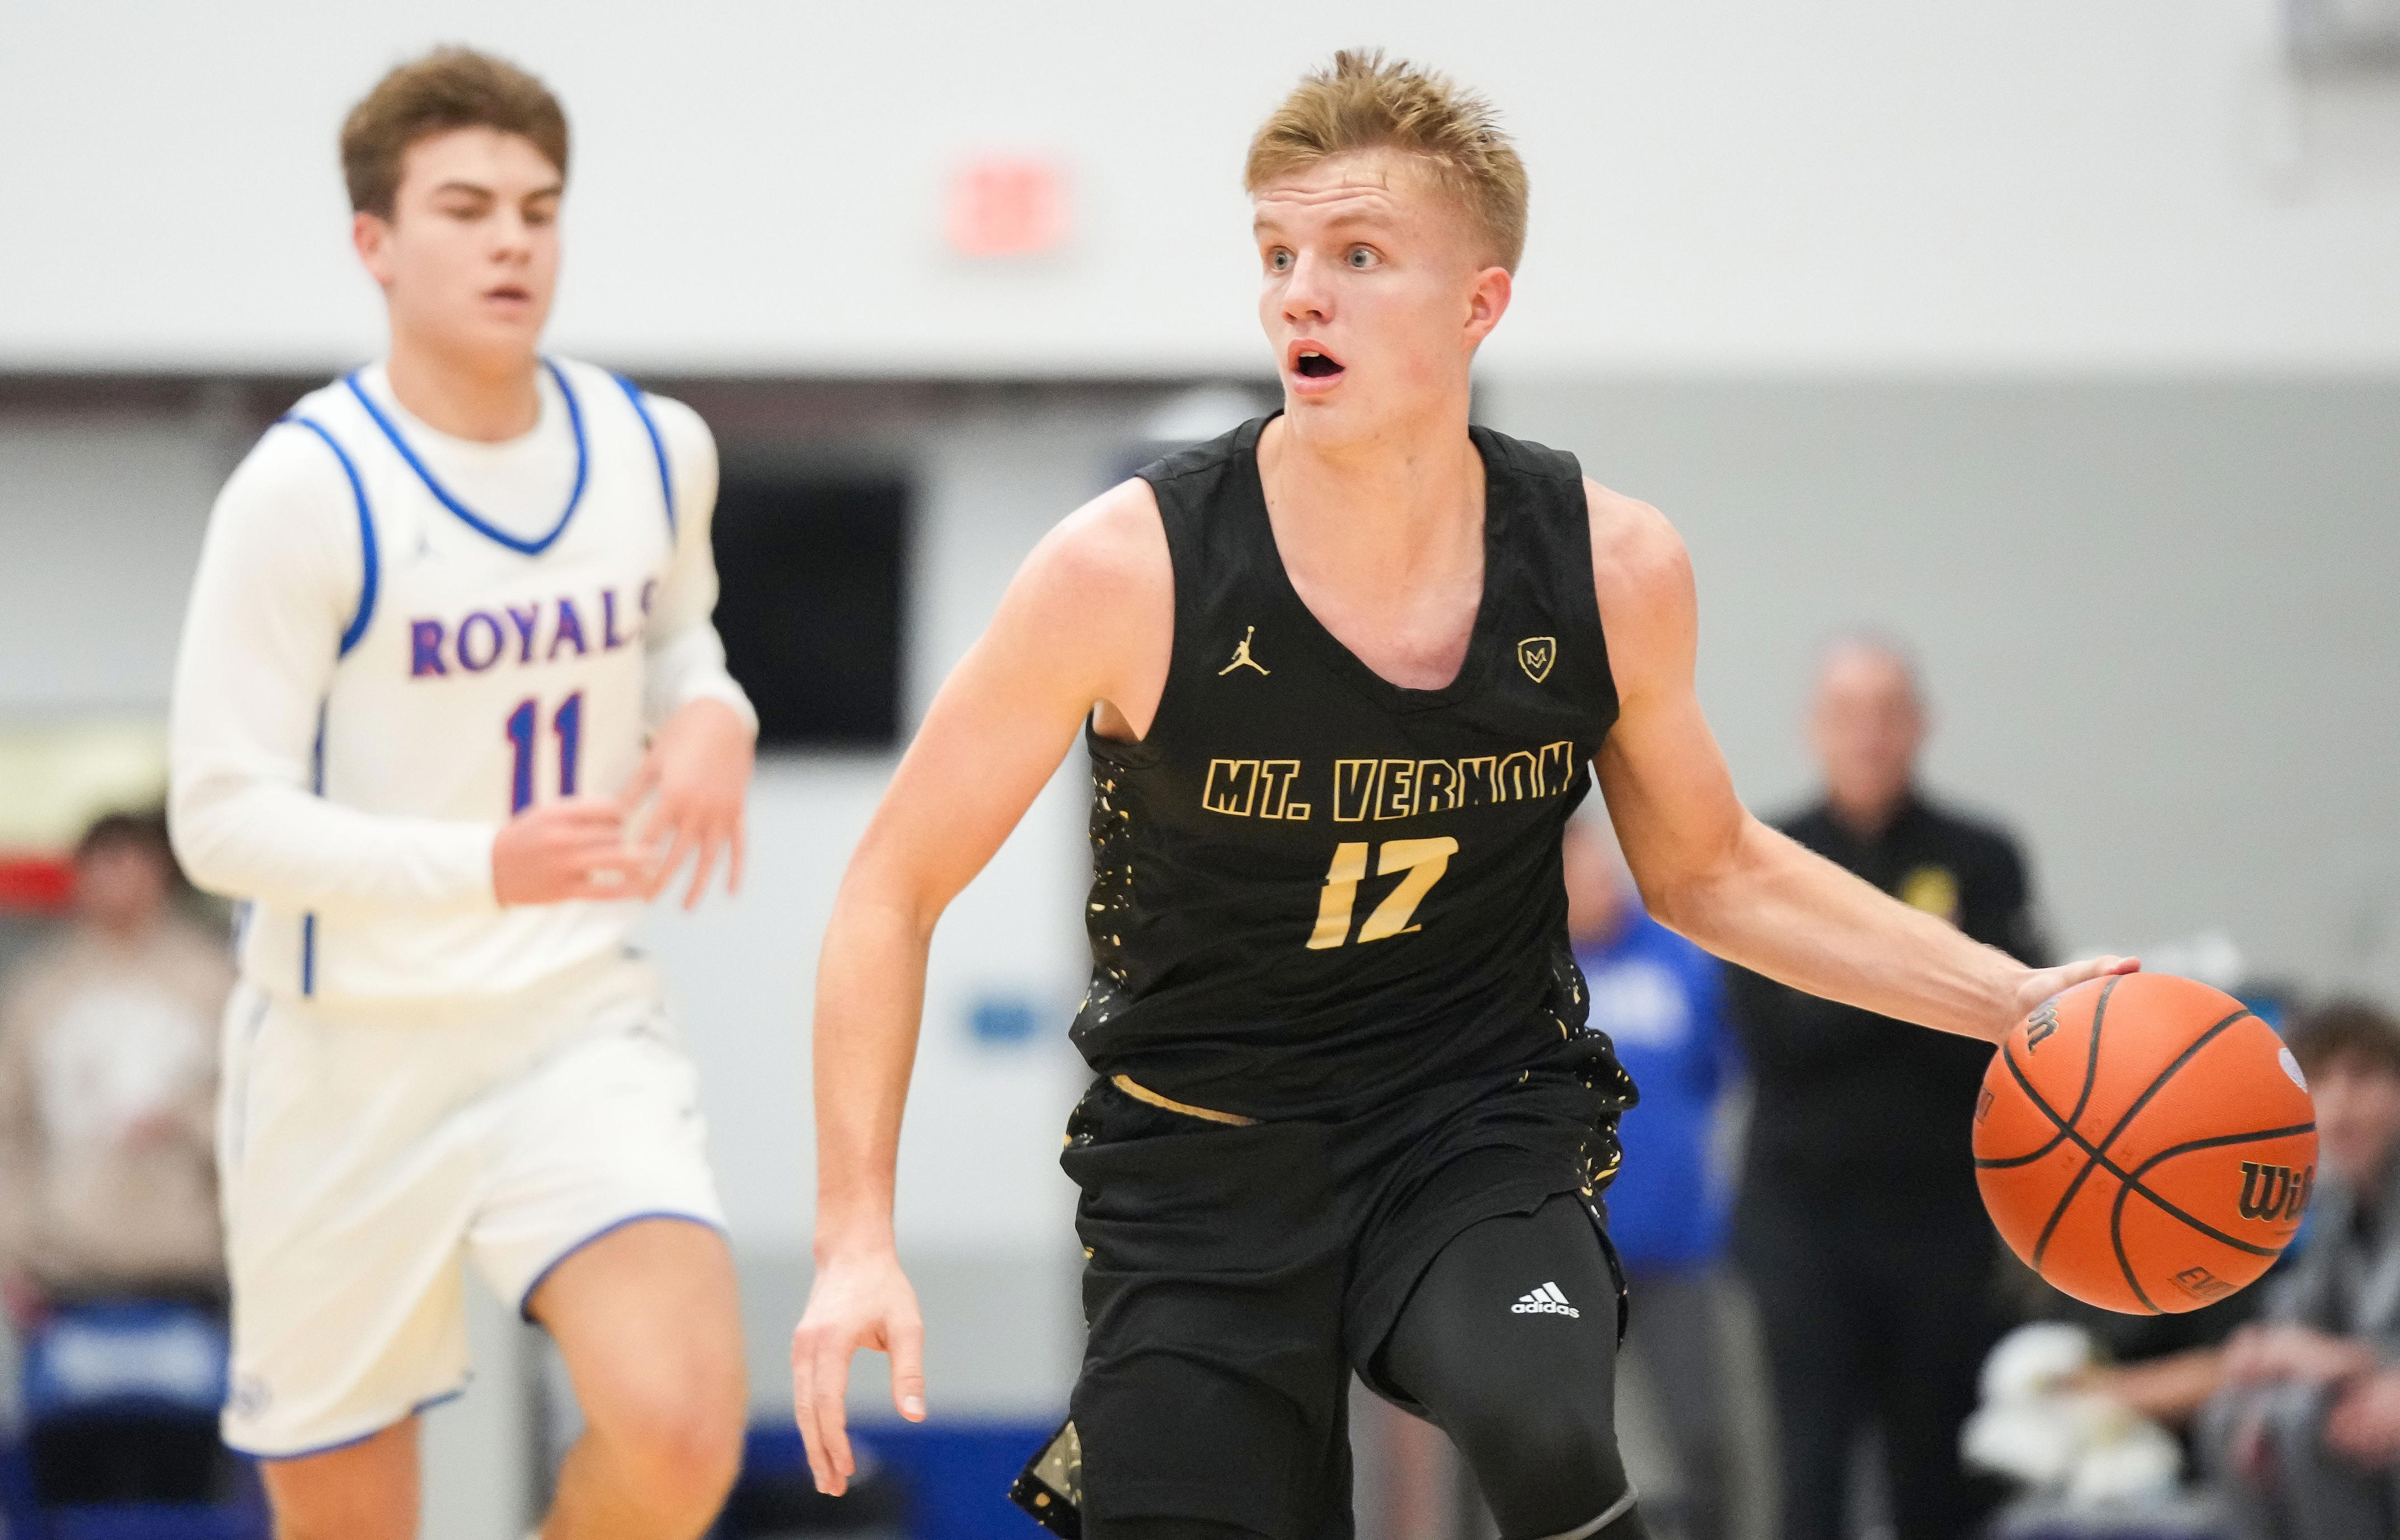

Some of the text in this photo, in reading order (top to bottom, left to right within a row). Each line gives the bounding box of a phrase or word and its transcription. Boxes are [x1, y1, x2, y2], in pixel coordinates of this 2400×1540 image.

[506, 691, 583, 816] 11
[1202, 741, 1573, 821] MT. VERNON
[1511, 1301, 1579, 1318] adidas
